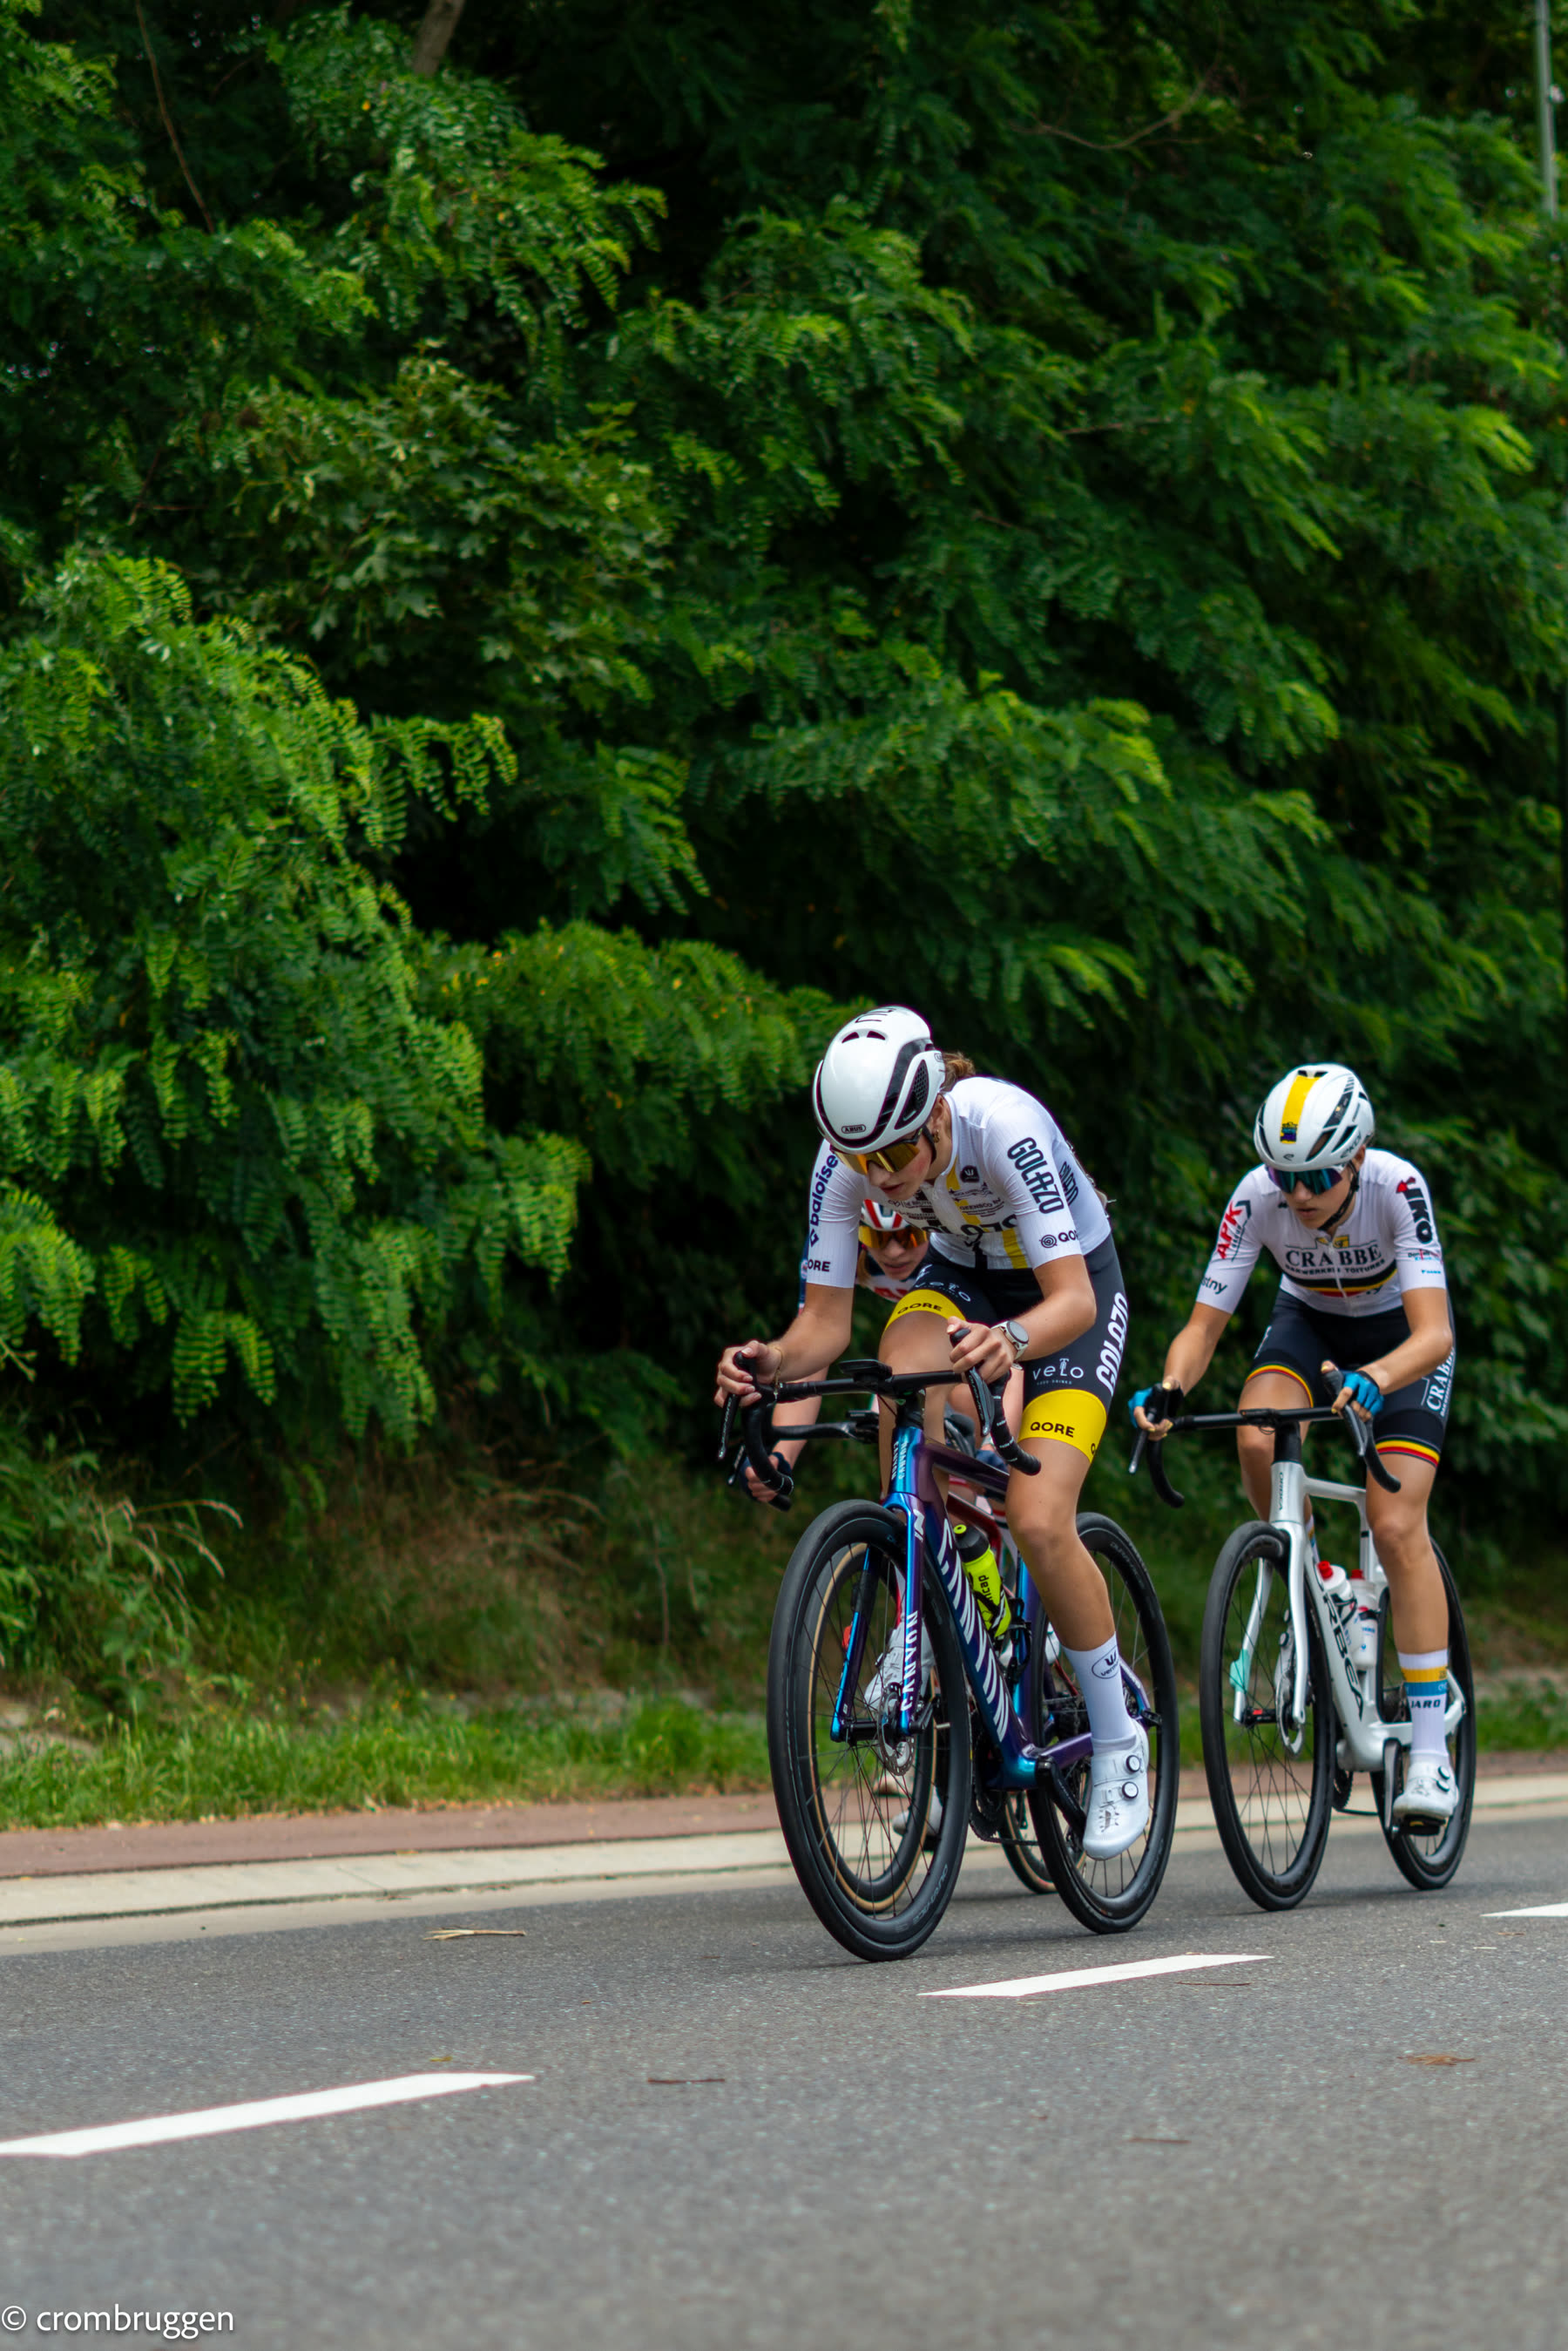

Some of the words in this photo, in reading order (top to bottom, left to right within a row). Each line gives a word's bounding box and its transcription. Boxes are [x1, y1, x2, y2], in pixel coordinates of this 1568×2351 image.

[810, 1153, 839, 1227] baloise
[1007, 1137, 1064, 1214] GOLAZO
[1217, 1201, 1242, 1259] APK
[1286, 1243, 1382, 1267] CRABBE
[1345, 1258, 1386, 1272] TOITURES
[897, 1303, 943, 1314] QORE
[1426, 1347, 1454, 1412] CRAB
[1031, 1422, 1075, 1438] QORE
[1313, 1555, 1363, 1722] ORBEA
